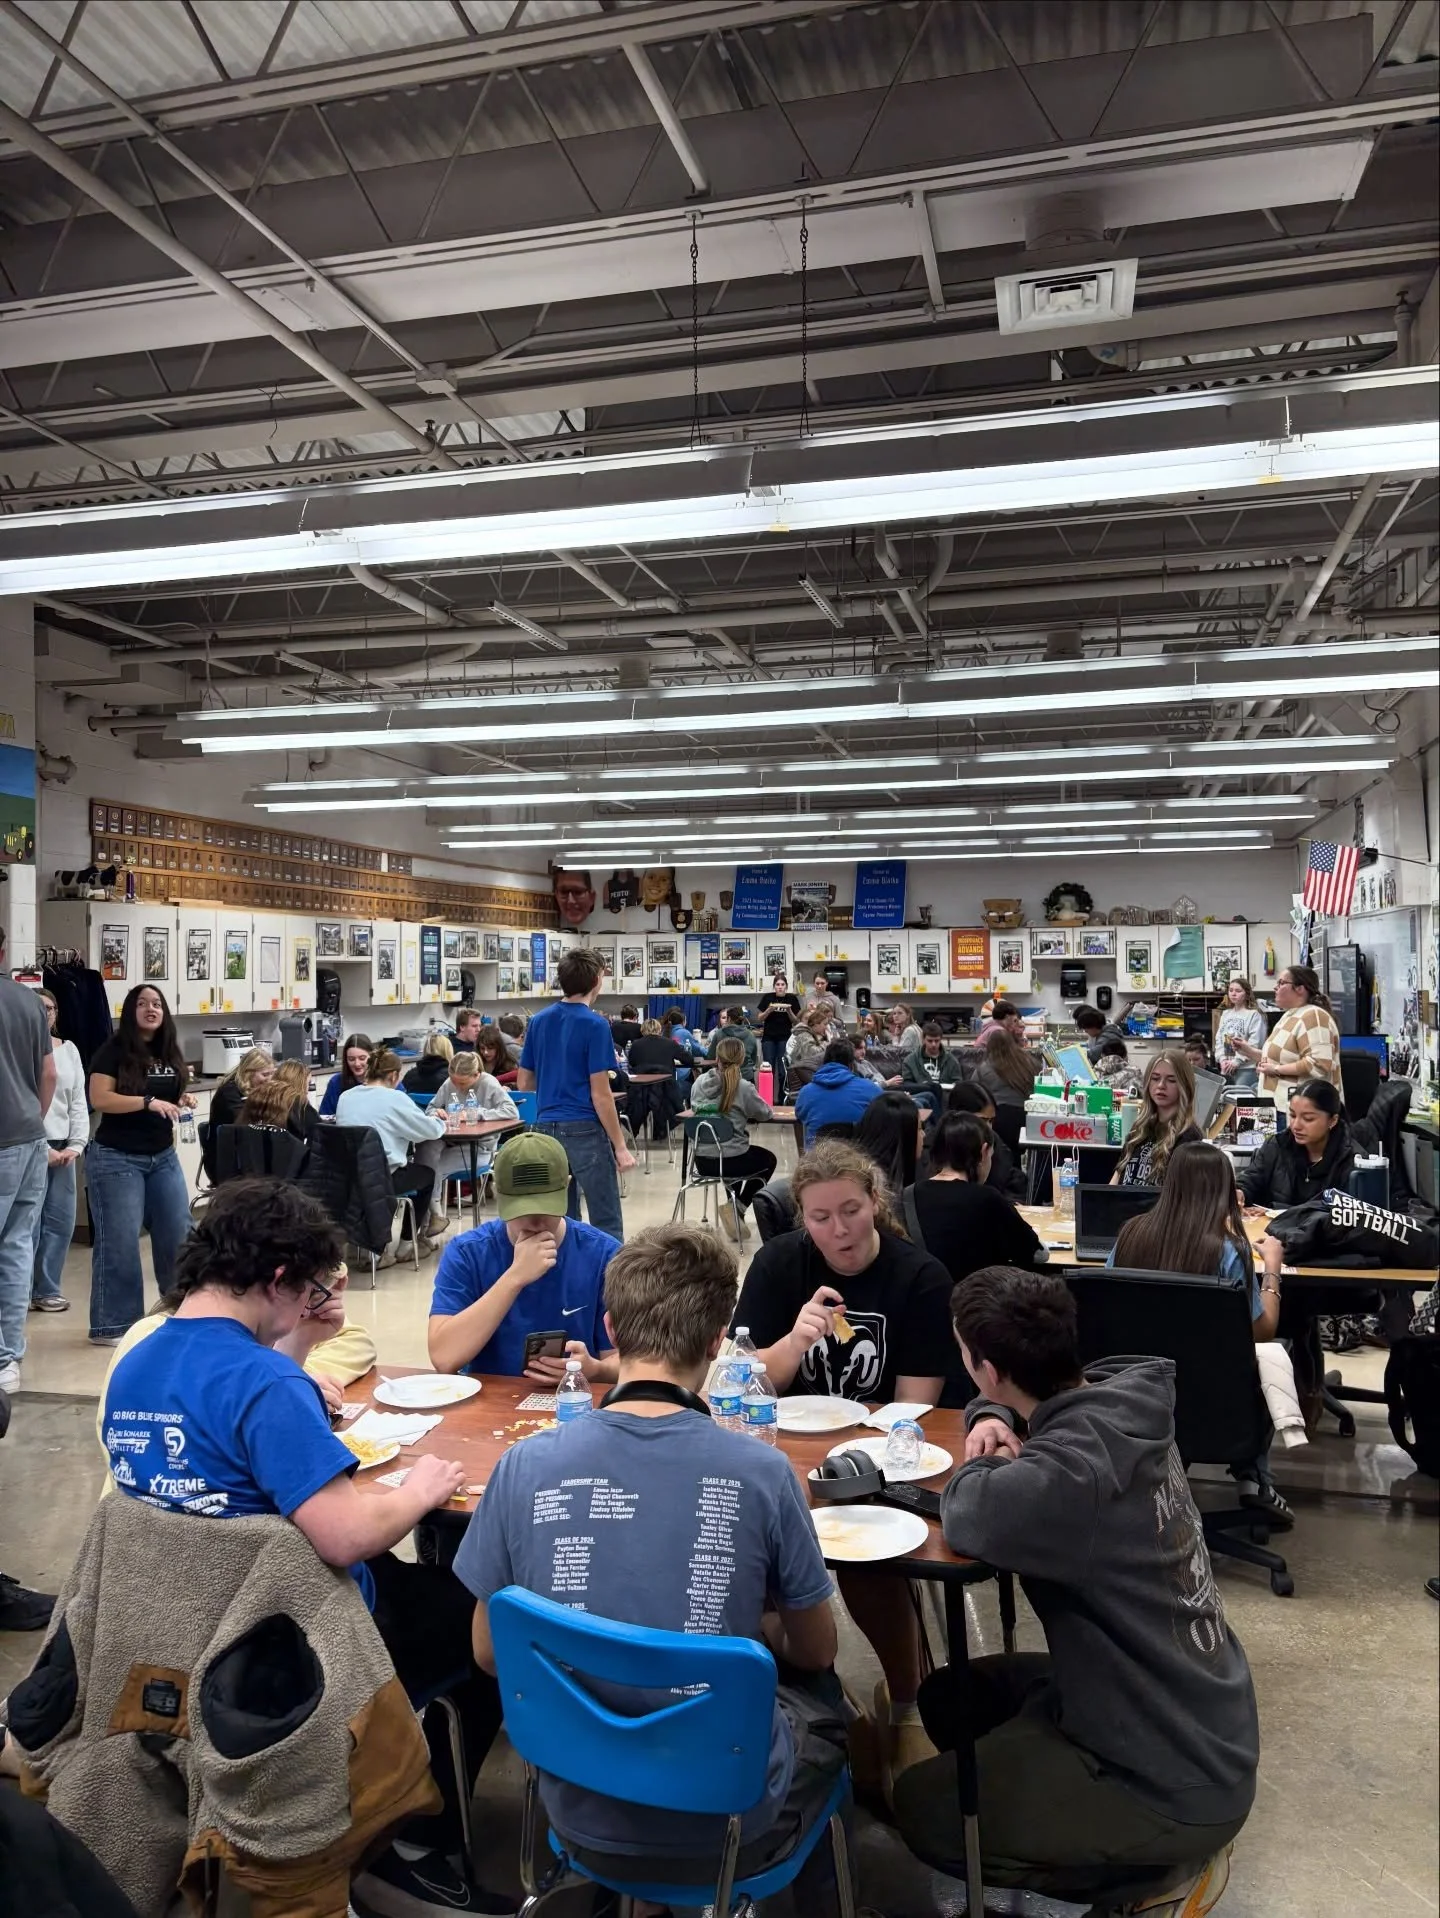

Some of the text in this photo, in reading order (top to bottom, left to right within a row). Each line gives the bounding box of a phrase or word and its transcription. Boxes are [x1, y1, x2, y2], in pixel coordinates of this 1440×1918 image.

[958, 945, 983, 953] ADVANCE
[1040, 1119, 1093, 1140] Coke
[1111, 1118, 1120, 1141] Sprite
[1333, 1195, 1422, 1232] ASKETBALL
[1331, 1208, 1408, 1245] SOFTBALL
[113, 1411, 121, 1420] GO
[121, 1411, 136, 1420] BIG
[138, 1411, 153, 1421] BLUE
[150, 1474, 206, 1494] XTREME
[561, 1478, 593, 1486] LEADERSHIP
